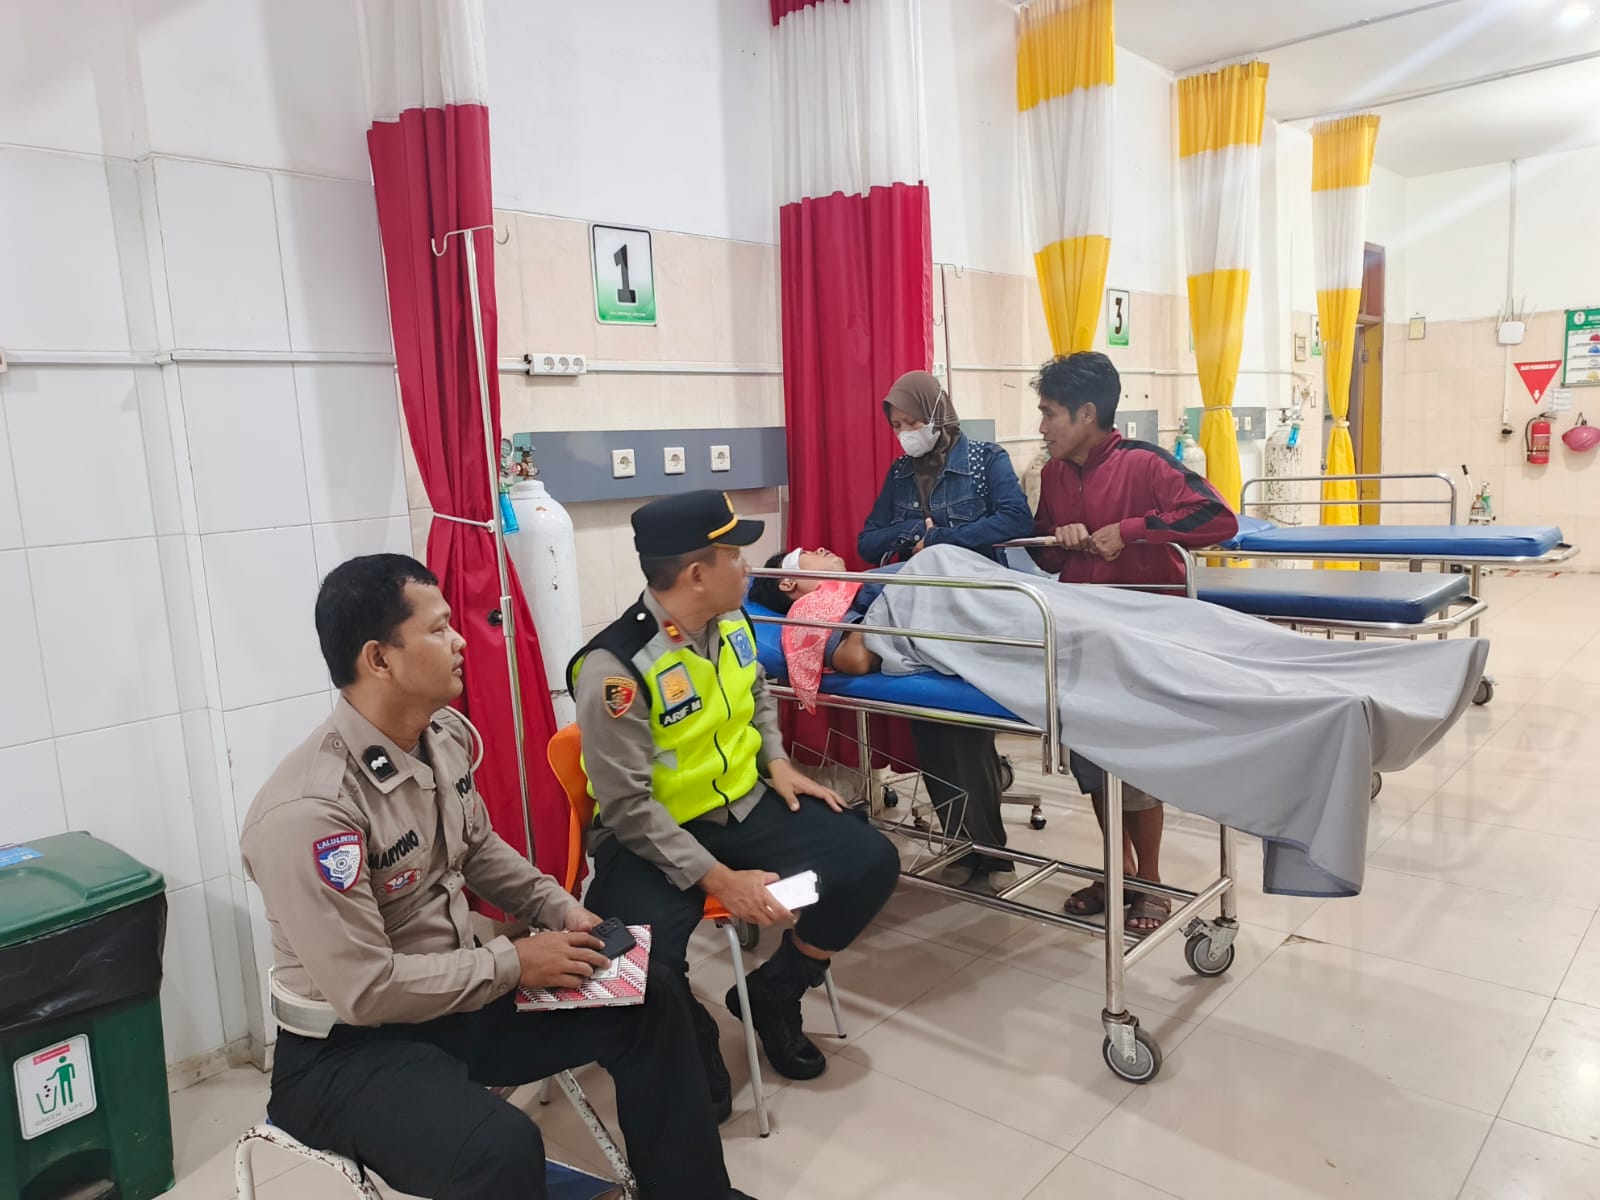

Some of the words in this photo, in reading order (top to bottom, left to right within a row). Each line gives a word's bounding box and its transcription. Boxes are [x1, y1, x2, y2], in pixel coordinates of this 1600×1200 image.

[613, 244, 636, 304] 1
[1115, 297, 1123, 335] 3
[663, 705, 689, 725] ARIF
[691, 699, 702, 711] M
